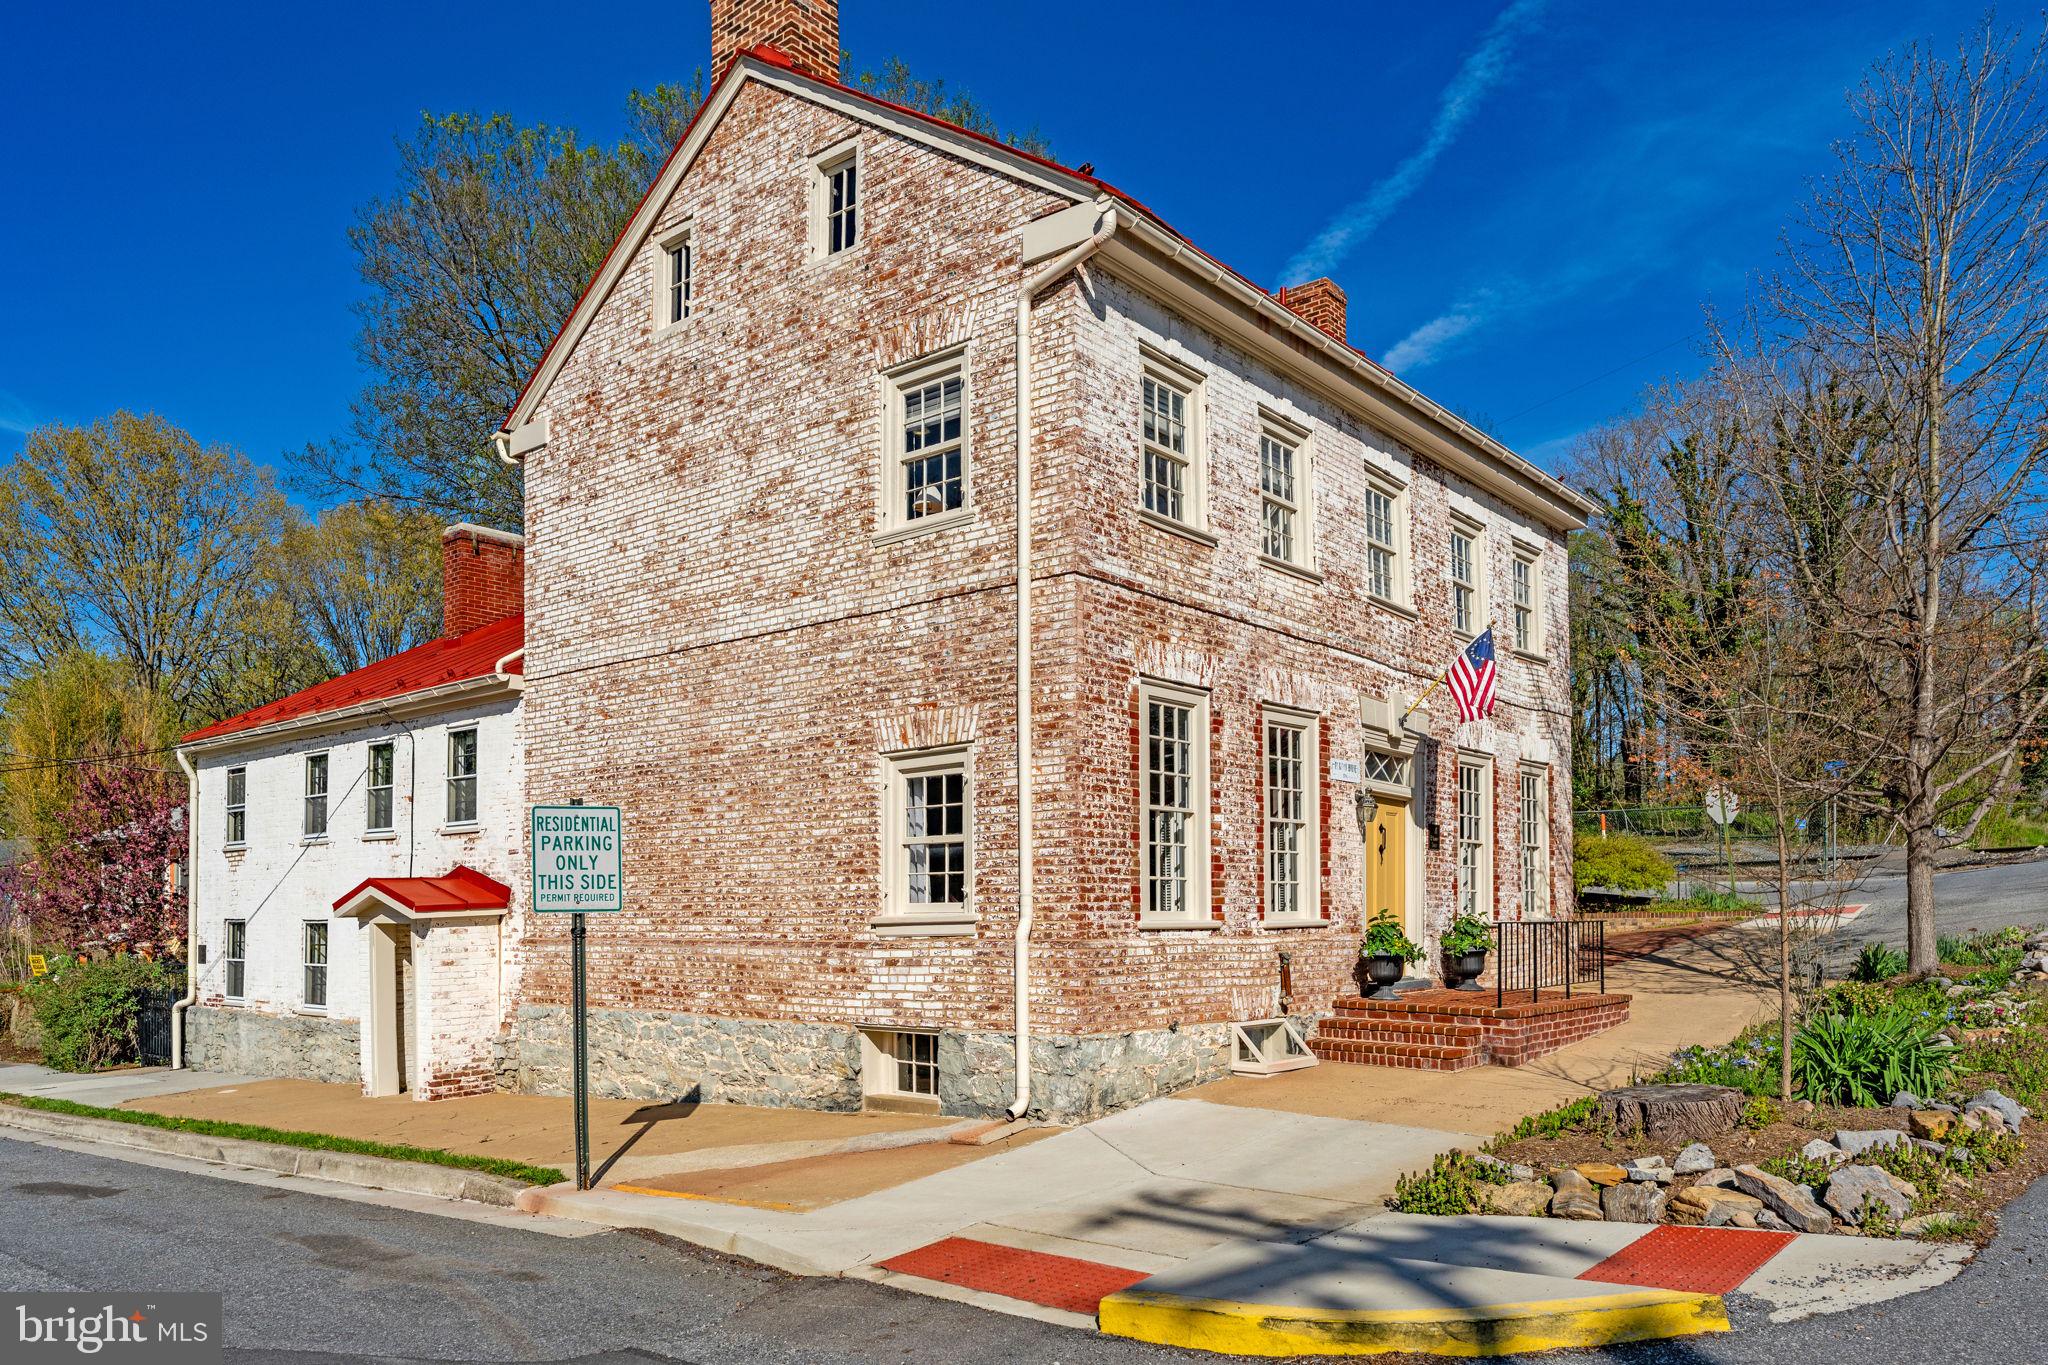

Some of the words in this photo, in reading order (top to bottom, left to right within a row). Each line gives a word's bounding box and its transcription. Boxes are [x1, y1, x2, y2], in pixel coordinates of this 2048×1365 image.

[537, 816, 616, 832] RESIDENTIAL
[541, 836, 612, 851] PARKING
[556, 855, 598, 870] ONLY
[538, 875, 574, 890] THIS
[581, 875, 616, 890] SIDE
[541, 894, 570, 902] PERMIT
[574, 894, 614, 902] REQUIRED
